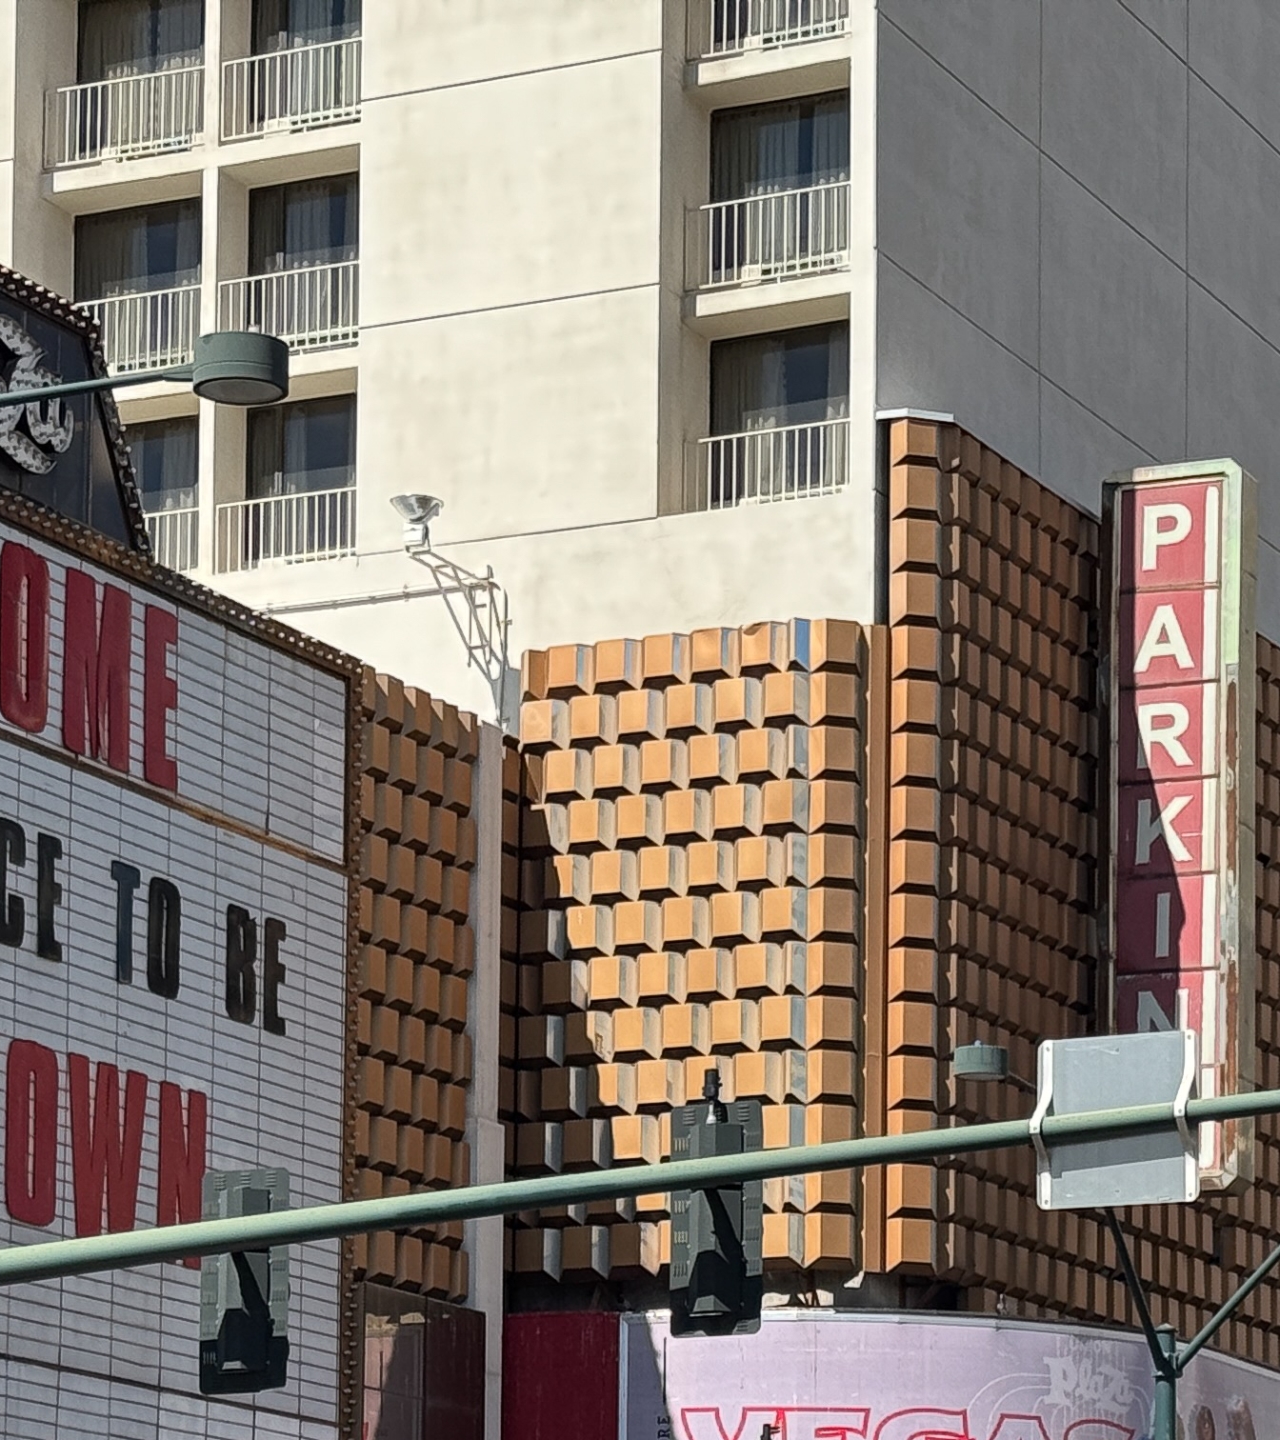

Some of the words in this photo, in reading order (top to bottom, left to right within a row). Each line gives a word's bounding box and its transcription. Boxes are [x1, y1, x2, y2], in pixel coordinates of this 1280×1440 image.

[1135, 501, 1194, 1032] PARKIN
[111, 860, 181, 999] TO
[225, 903, 287, 1036] BE
